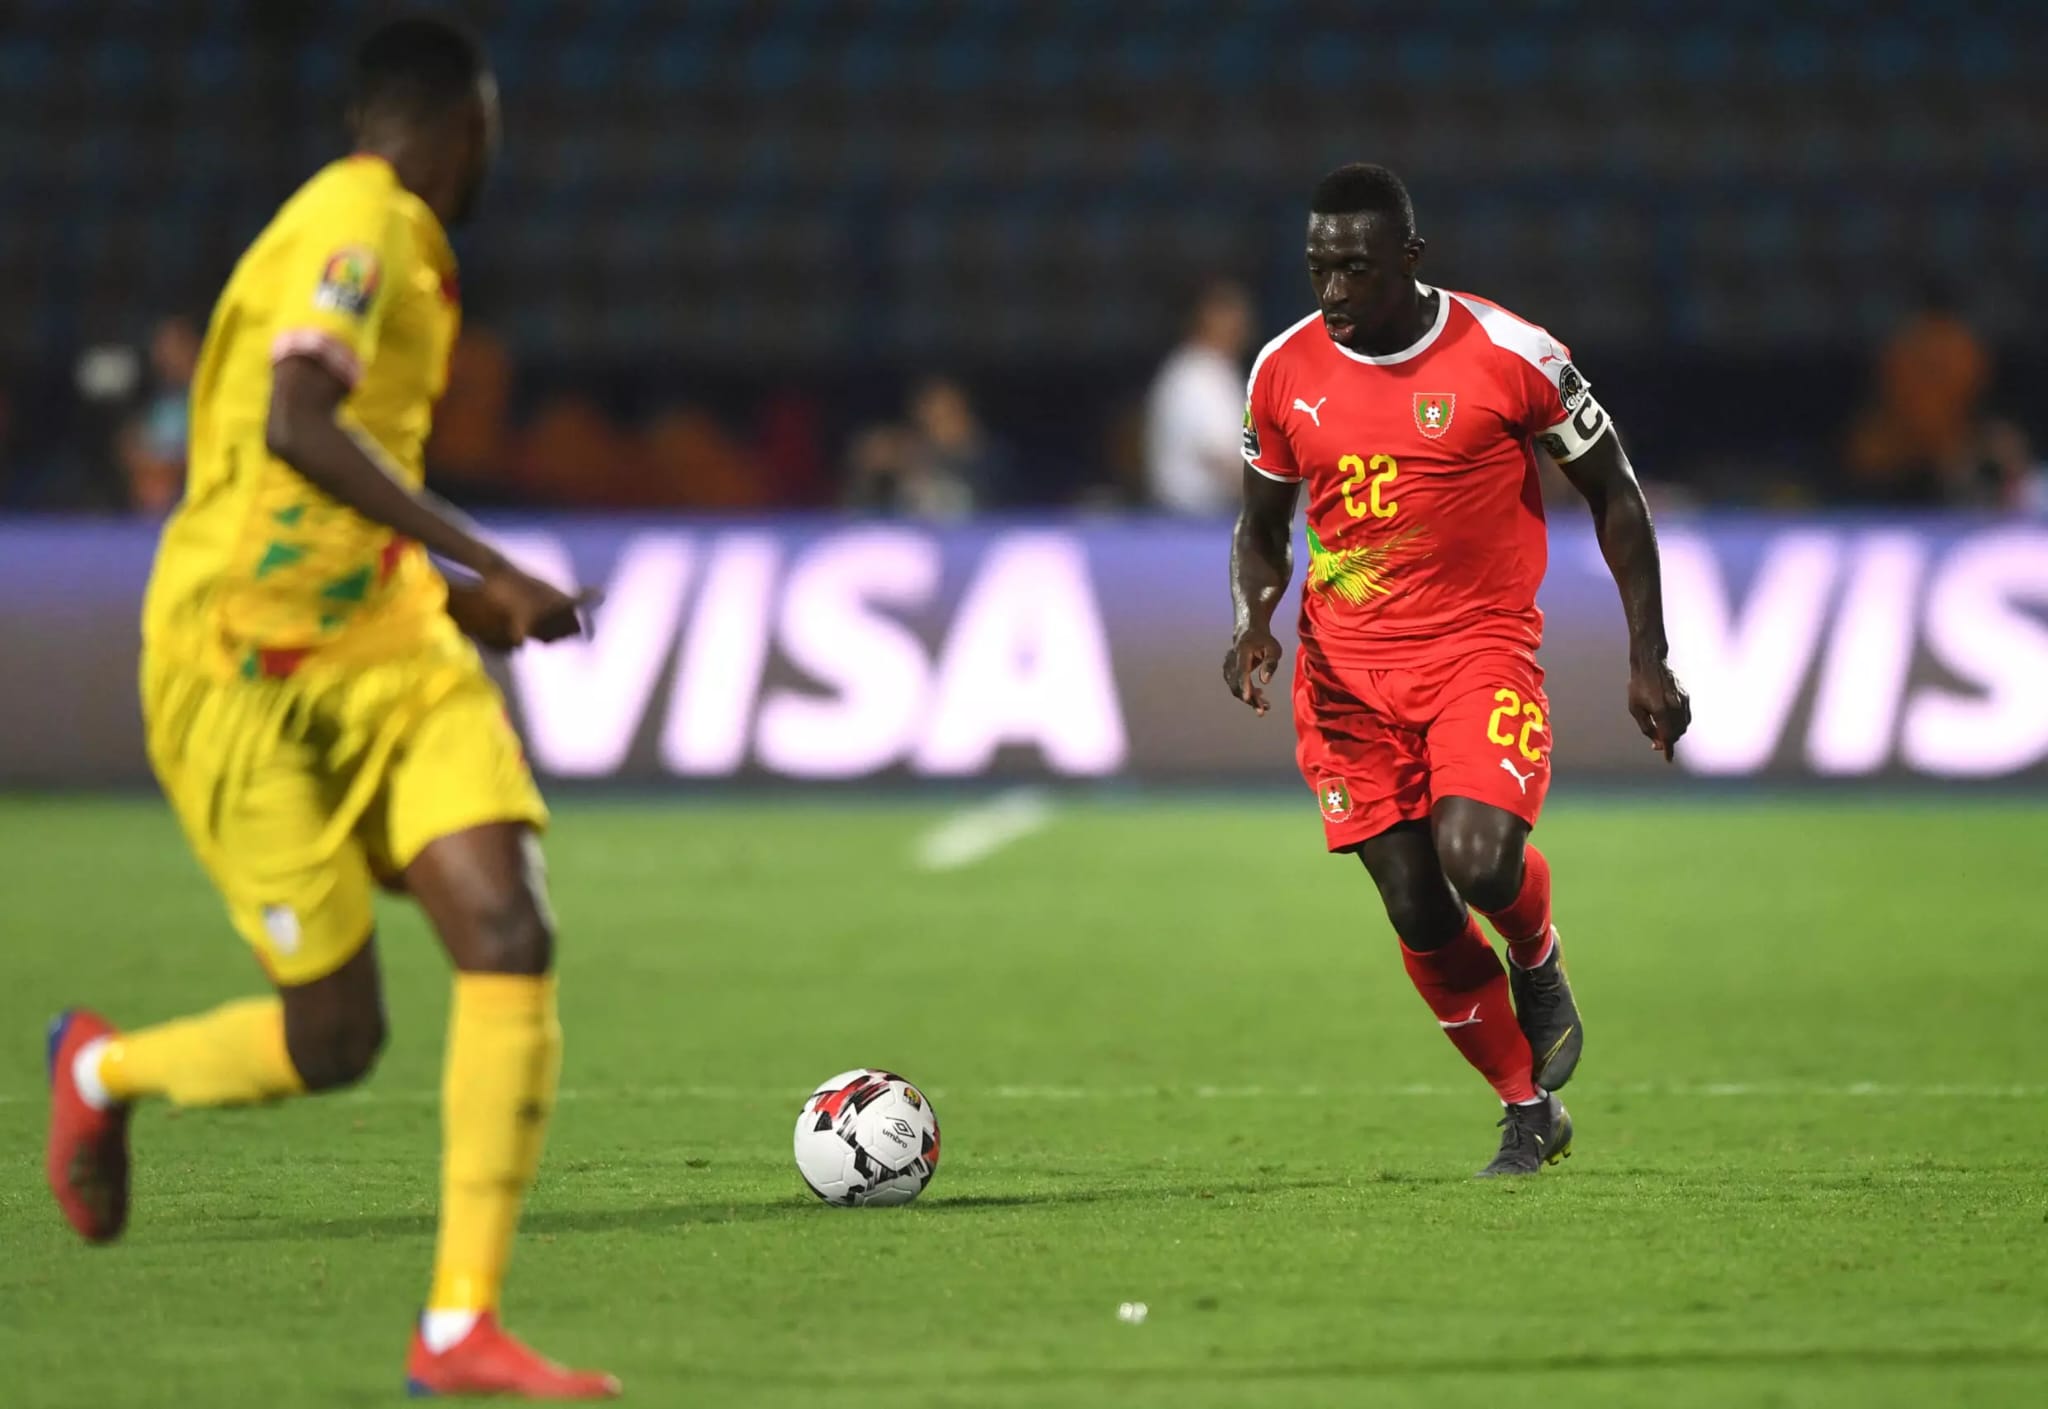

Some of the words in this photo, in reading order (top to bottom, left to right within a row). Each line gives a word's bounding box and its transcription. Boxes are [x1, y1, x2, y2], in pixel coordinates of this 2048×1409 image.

[1572, 396, 1604, 441] C
[1338, 454, 1399, 518] 22
[474, 525, 1128, 777] VISA
[1487, 688, 1544, 762] 22
[882, 1129, 908, 1149] umbro
